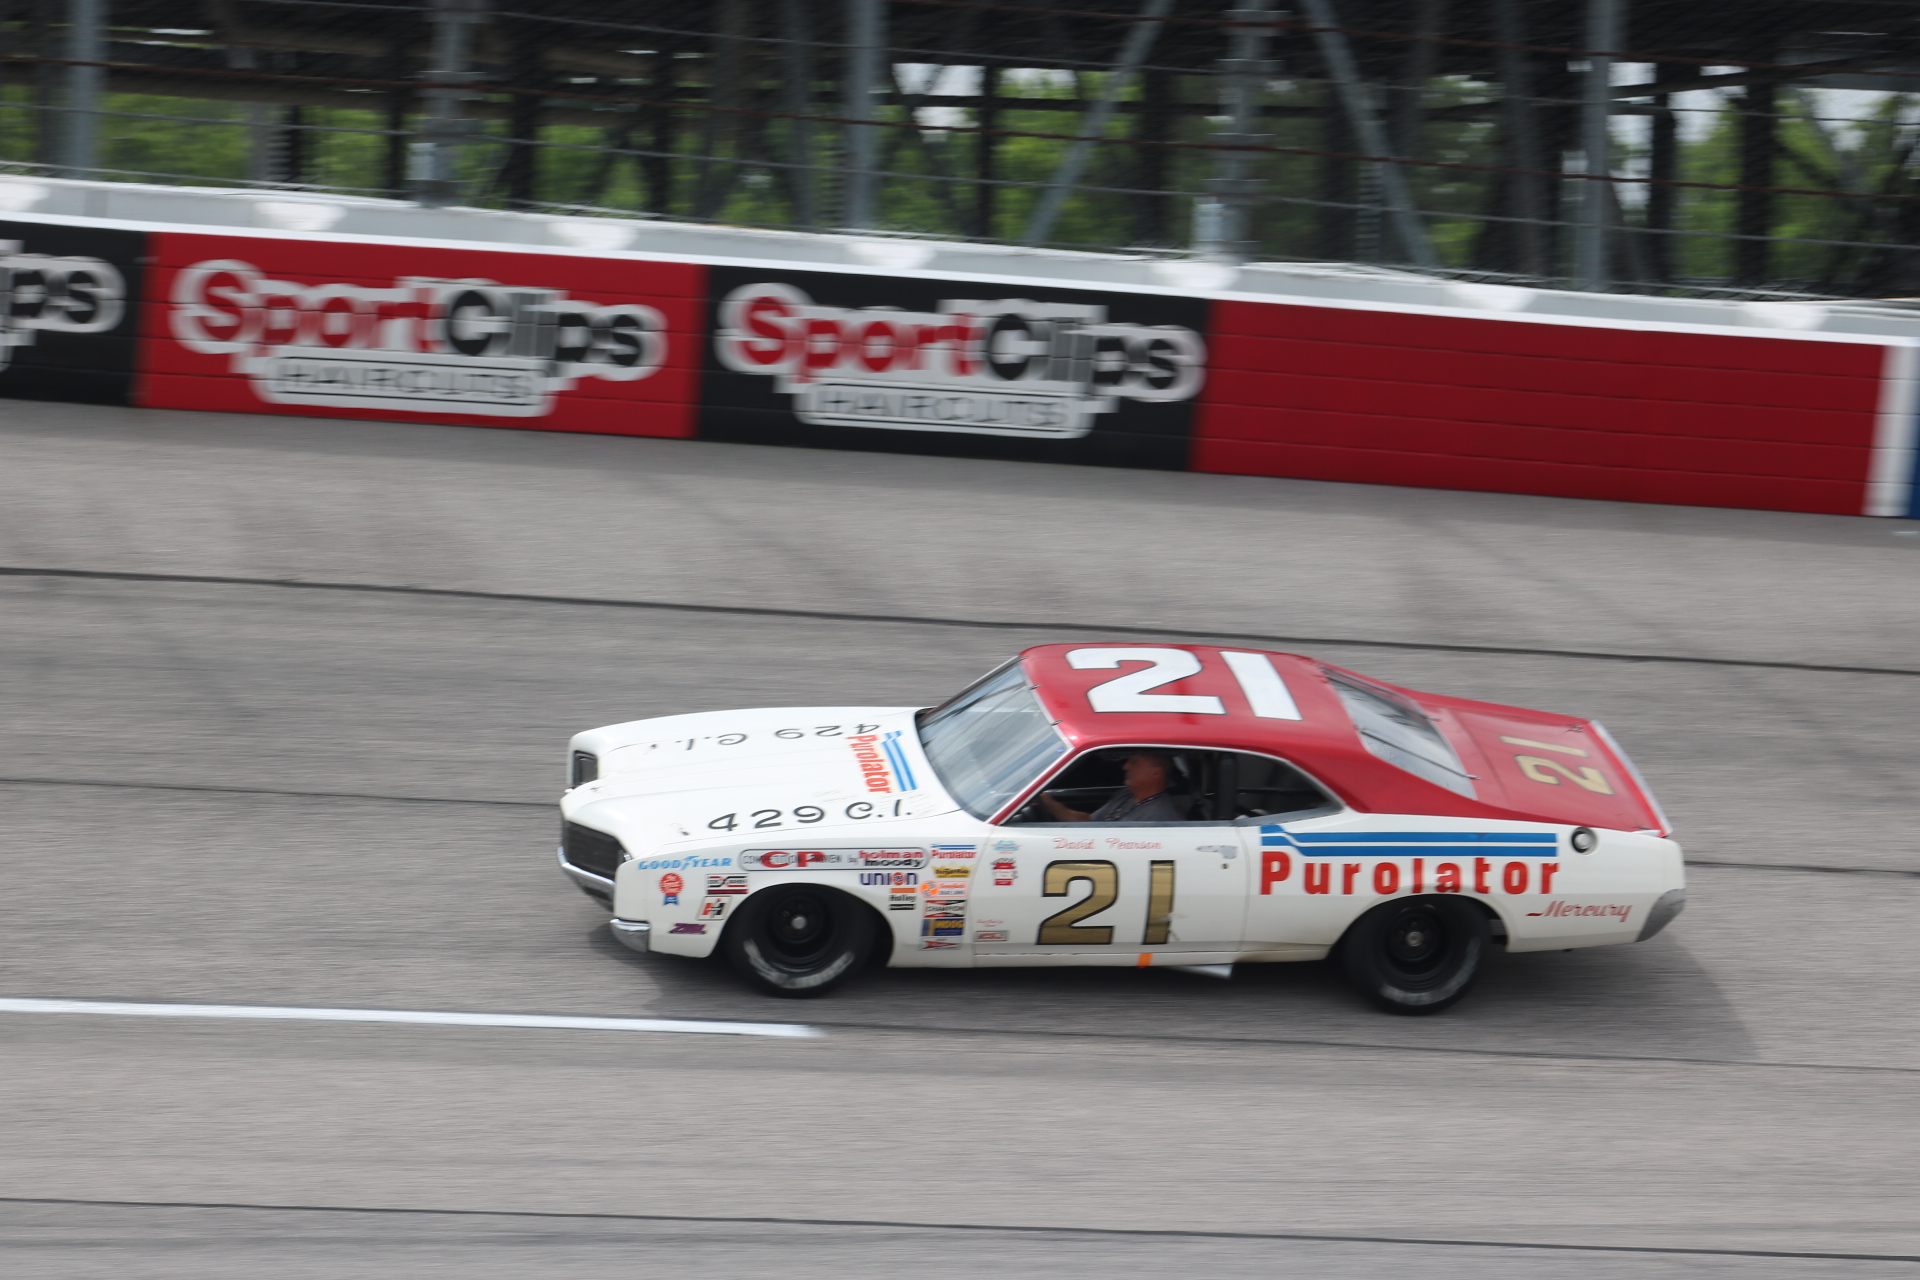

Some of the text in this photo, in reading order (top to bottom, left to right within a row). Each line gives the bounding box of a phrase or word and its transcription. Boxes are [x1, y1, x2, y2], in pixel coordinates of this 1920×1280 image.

[1065, 647, 1303, 721] 21
[846, 734, 893, 794] Purolator
[1499, 735, 1614, 796] 21
[707, 805, 826, 832] 429
[1053, 837, 1163, 850] David Pearson
[1259, 850, 1561, 896] Purolator
[1035, 859, 1175, 945] 21
[1528, 900, 1634, 923] Mercury
